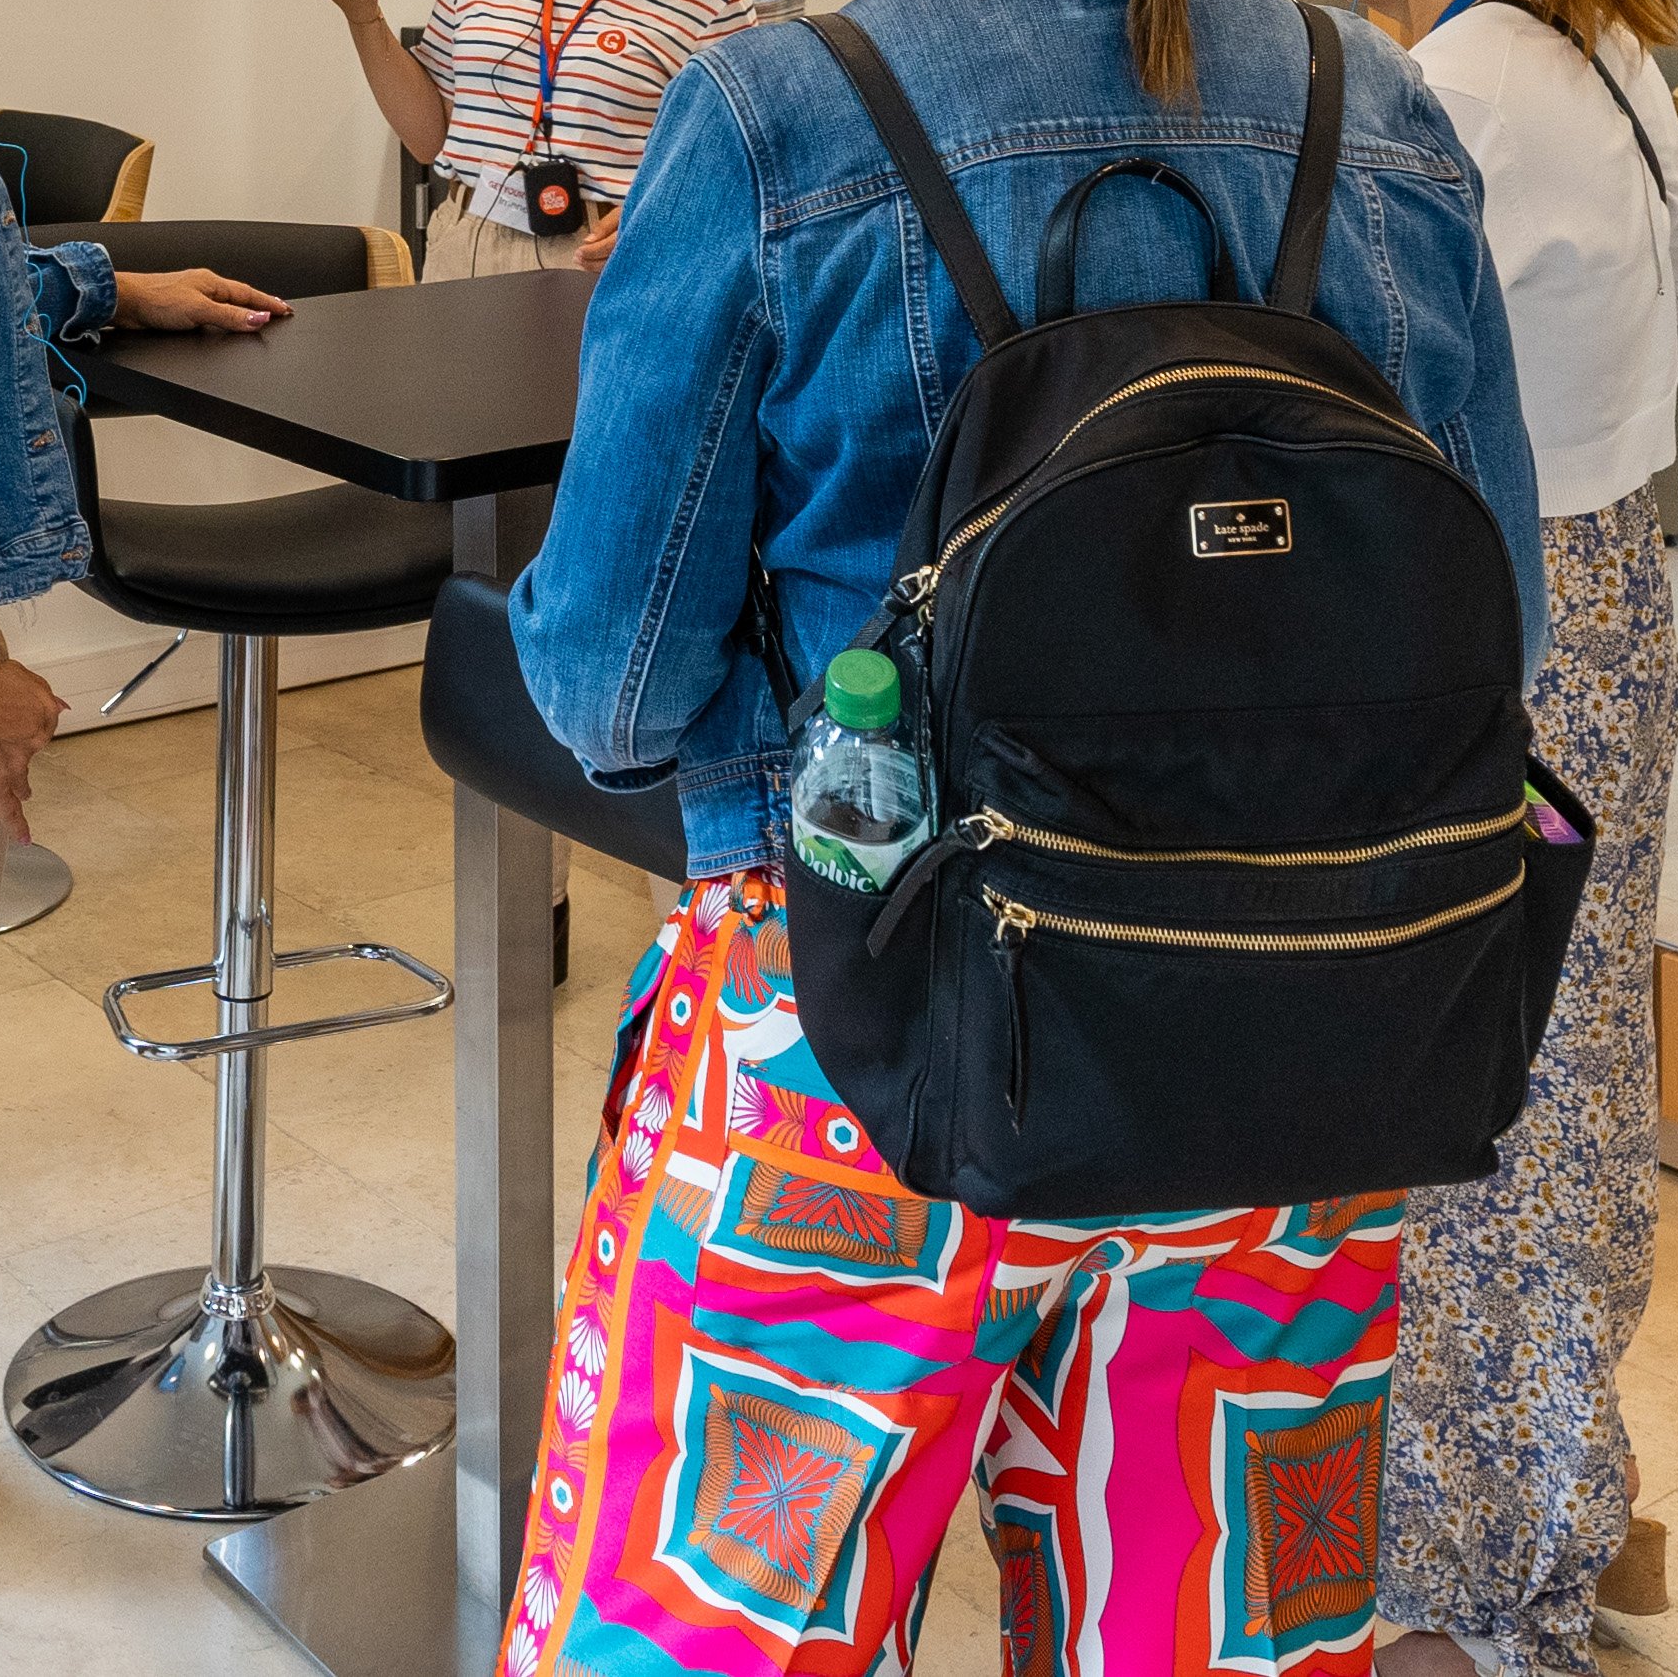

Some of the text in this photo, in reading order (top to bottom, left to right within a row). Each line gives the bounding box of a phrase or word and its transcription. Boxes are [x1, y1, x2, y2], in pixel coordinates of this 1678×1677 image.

[1214, 522, 1269, 535] kate spade
[797, 842, 874, 893] Volvic
